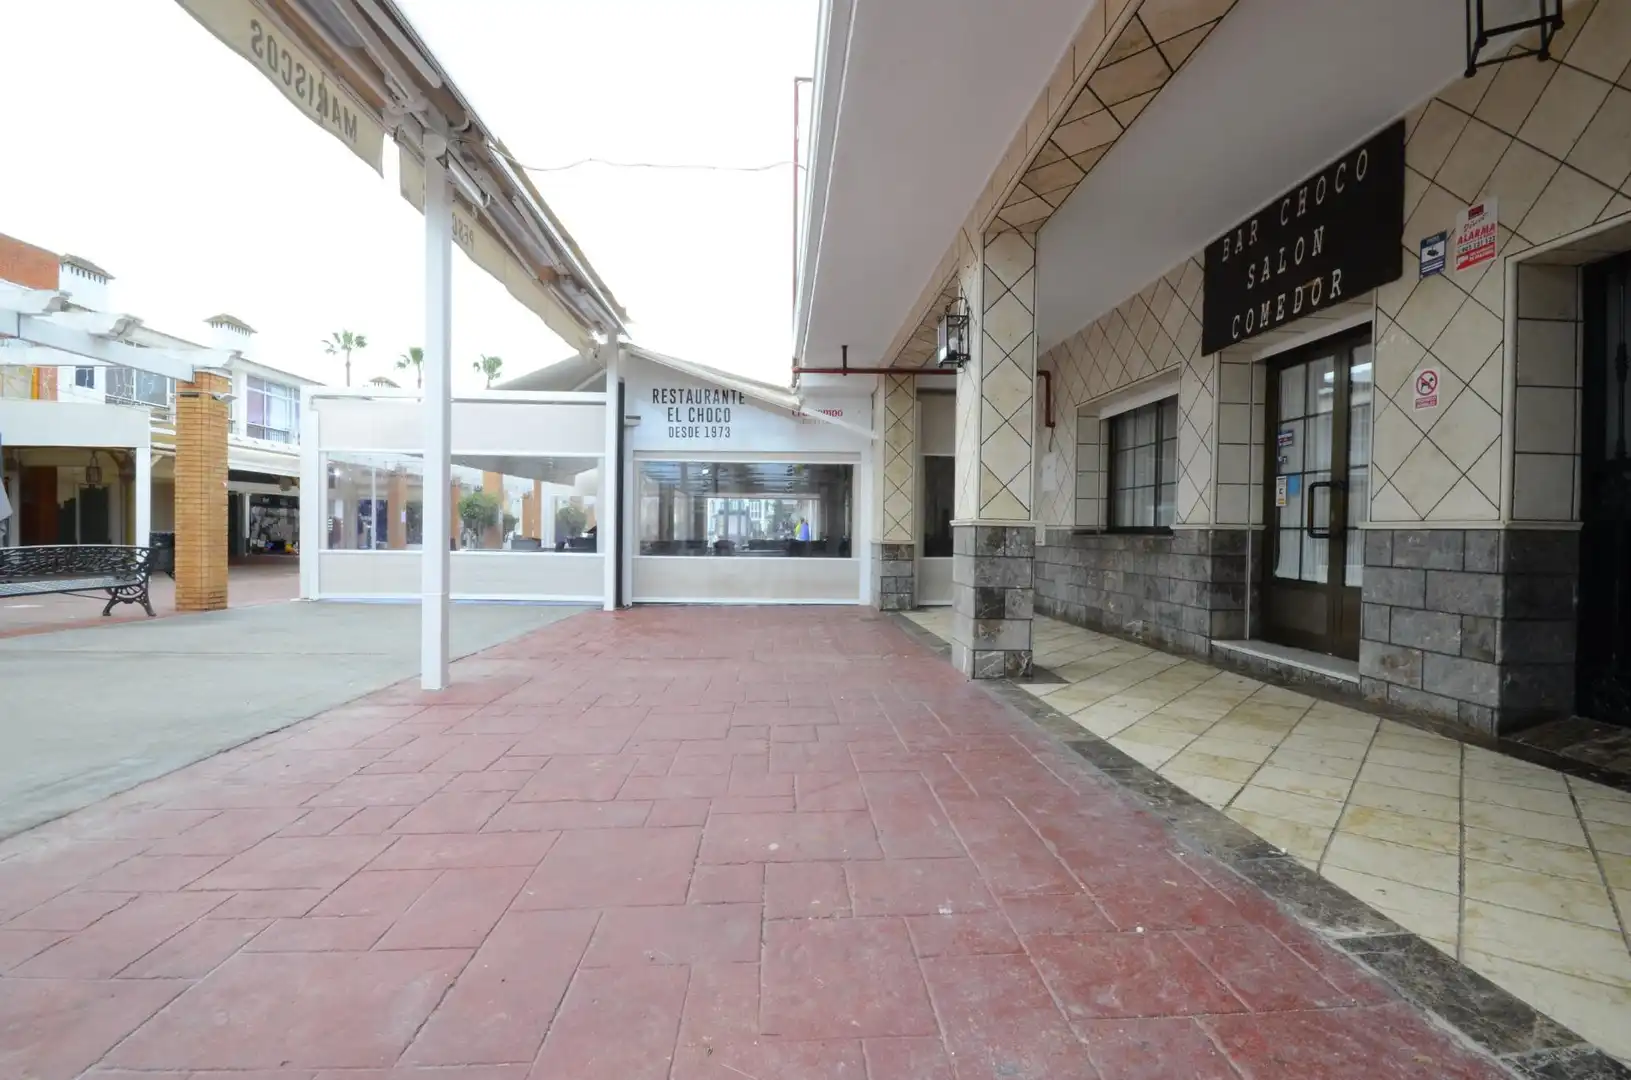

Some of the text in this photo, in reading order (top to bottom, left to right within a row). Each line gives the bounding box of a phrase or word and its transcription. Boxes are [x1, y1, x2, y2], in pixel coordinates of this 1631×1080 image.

[1222, 149, 1368, 262] BAR CHOCO
[1457, 222, 1496, 246] ALARMA
[1247, 225, 1325, 290] SALON
[1232, 268, 1342, 339] COMEDOR
[652, 388, 745, 405] RESTAURANTE
[667, 407, 731, 423] EL CHOCO
[668, 426, 731, 438] DESDE 1973
